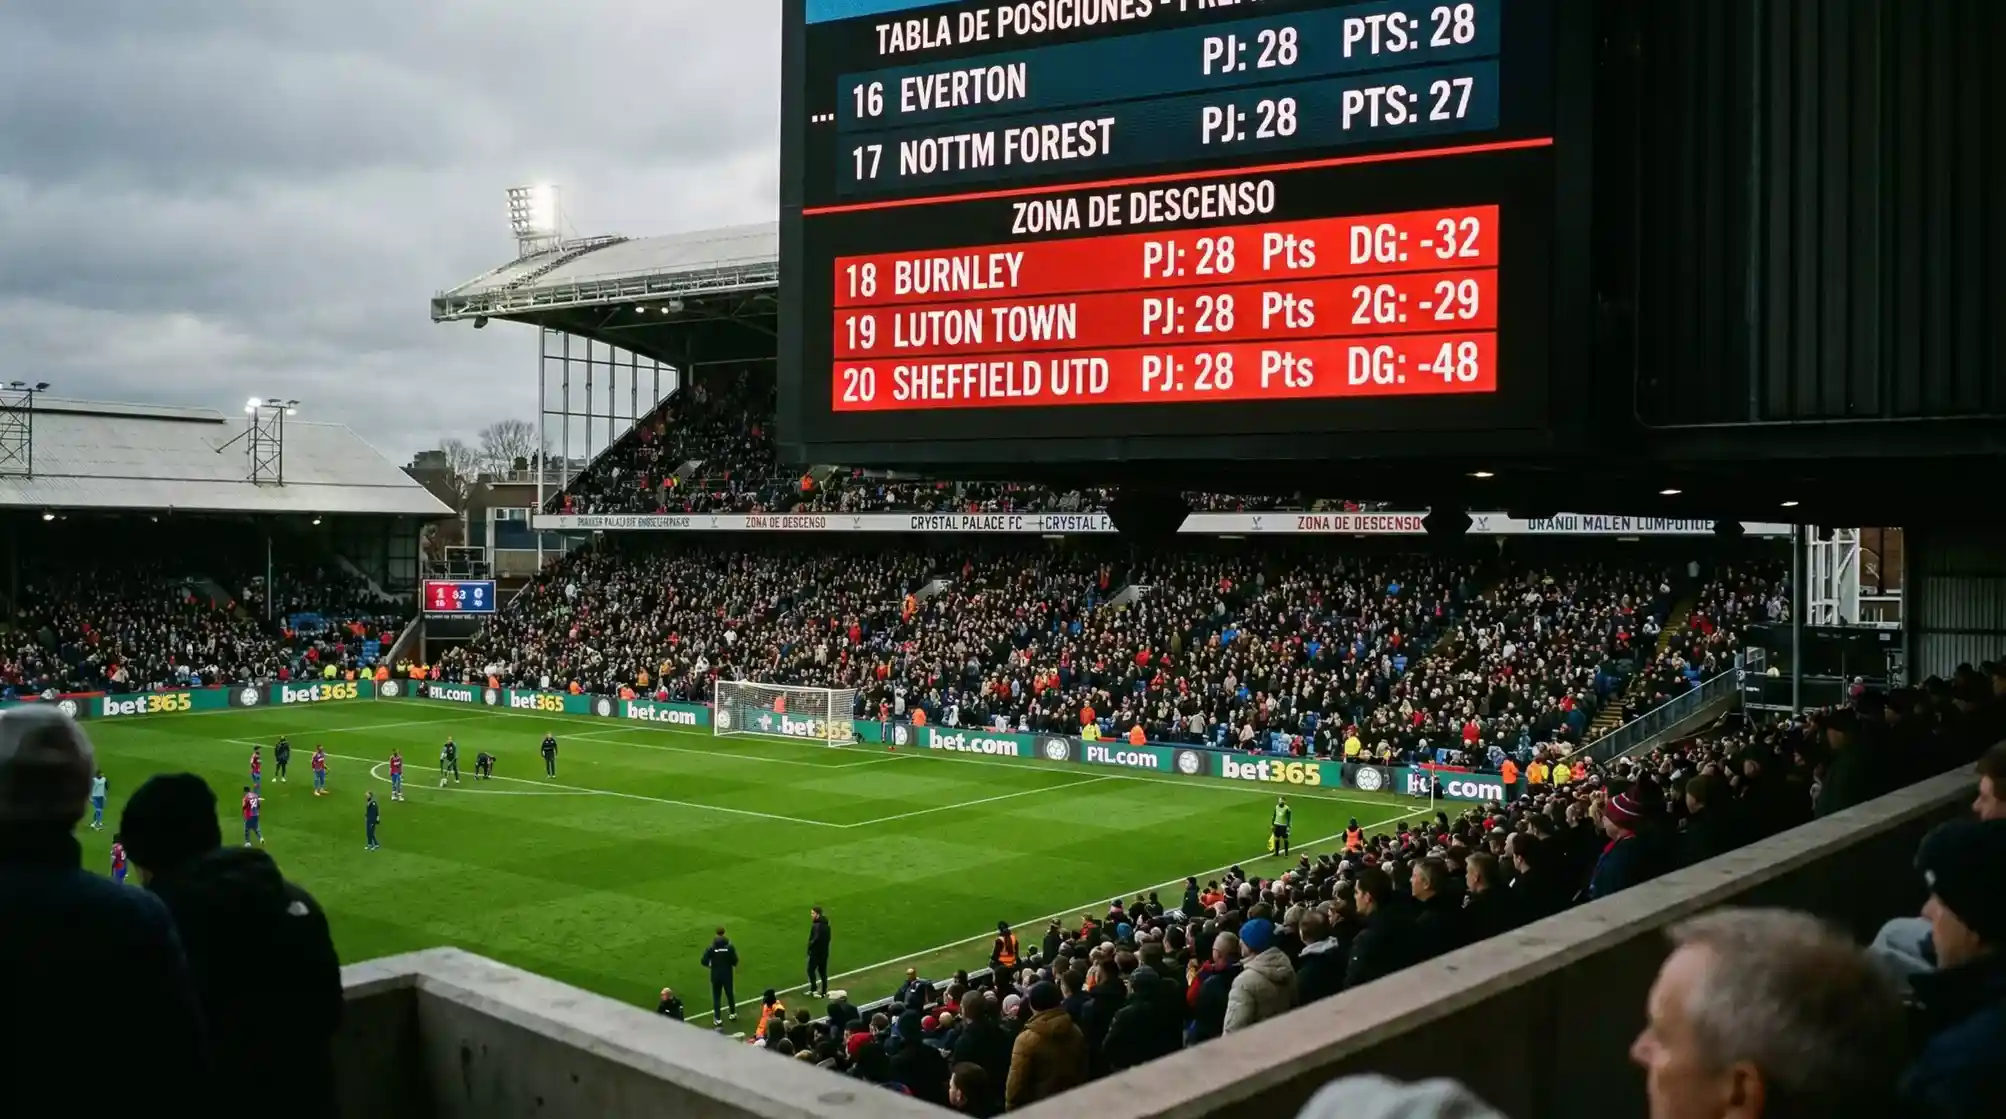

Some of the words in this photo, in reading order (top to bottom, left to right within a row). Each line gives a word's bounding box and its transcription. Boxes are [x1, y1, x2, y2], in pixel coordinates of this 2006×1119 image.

[876, 16, 952, 55] TABLA
[959, 9, 990, 44] DE
[998, 0, 1153, 37] POSICIONES
[854, 82, 884, 118] 16
[901, 63, 1026, 113] EVERTON
[1204, 35, 1247, 76] PJ:
[1258, 27, 1298, 69] 28
[1344, 12, 1419, 58] PTS:
[1431, 3, 1475, 48] 28
[853, 145, 883, 181] 17
[901, 132, 995, 176] NOTTM
[1005, 118, 1115, 165] FOREST
[1203, 104, 1246, 145] PJ:
[1257, 98, 1297, 139] 28
[1343, 85, 1418, 130] PTS:
[1430, 77, 1474, 121] 27
[1012, 198, 1081, 234] ZONA
[1089, 194, 1122, 228] DE
[1130, 180, 1275, 225] DESCENSO
[847, 263, 877, 298] 18
[895, 252, 1024, 295] BURNLEY
[1144, 241, 1185, 278] PJ:
[1196, 236, 1235, 275] 28
[1263, 233, 1316, 271] Pts
[1351, 224, 1408, 265] DG:
[1420, 217, 1480, 259] -32
[846, 315, 876, 350] 19
[895, 309, 983, 348] LUTON
[992, 303, 1077, 343] TOWN
[1144, 298, 1185, 336] PJ:
[1195, 294, 1234, 333] 28
[1263, 292, 1315, 329] Pts
[1352, 284, 1407, 325] 2G:
[1420, 279, 1479, 321] -29
[844, 367, 876, 402] 20
[893, 361, 1042, 401] SHEFFIELD
[1051, 358, 1109, 396] UTD
[1143, 355, 1184, 392] PJ:
[1195, 352, 1234, 391] 28
[1261, 351, 1314, 389] Pts
[1349, 345, 1406, 386] DG:
[1418, 342, 1479, 383] -48
[745, 516, 767, 529] ZONA
[782, 516, 826, 529] DESCENSO
[911, 516, 959, 530] CRYSTAL
[962, 516, 1004, 530] PALACE
[1008, 516, 1023, 530] FC
[1045, 516, 1097, 531] CRYSTAL
[1297, 516, 1330, 531] ZONA
[1354, 516, 1421, 531] DESCENSO
[103, 692, 192, 716] bet365
[282, 682, 358, 703] bet365
[510, 691, 565, 712] bet365
[627, 702, 696, 725] bet.com
[929, 729, 1019, 756] bet.com
[1222, 754, 1321, 786] bet365
